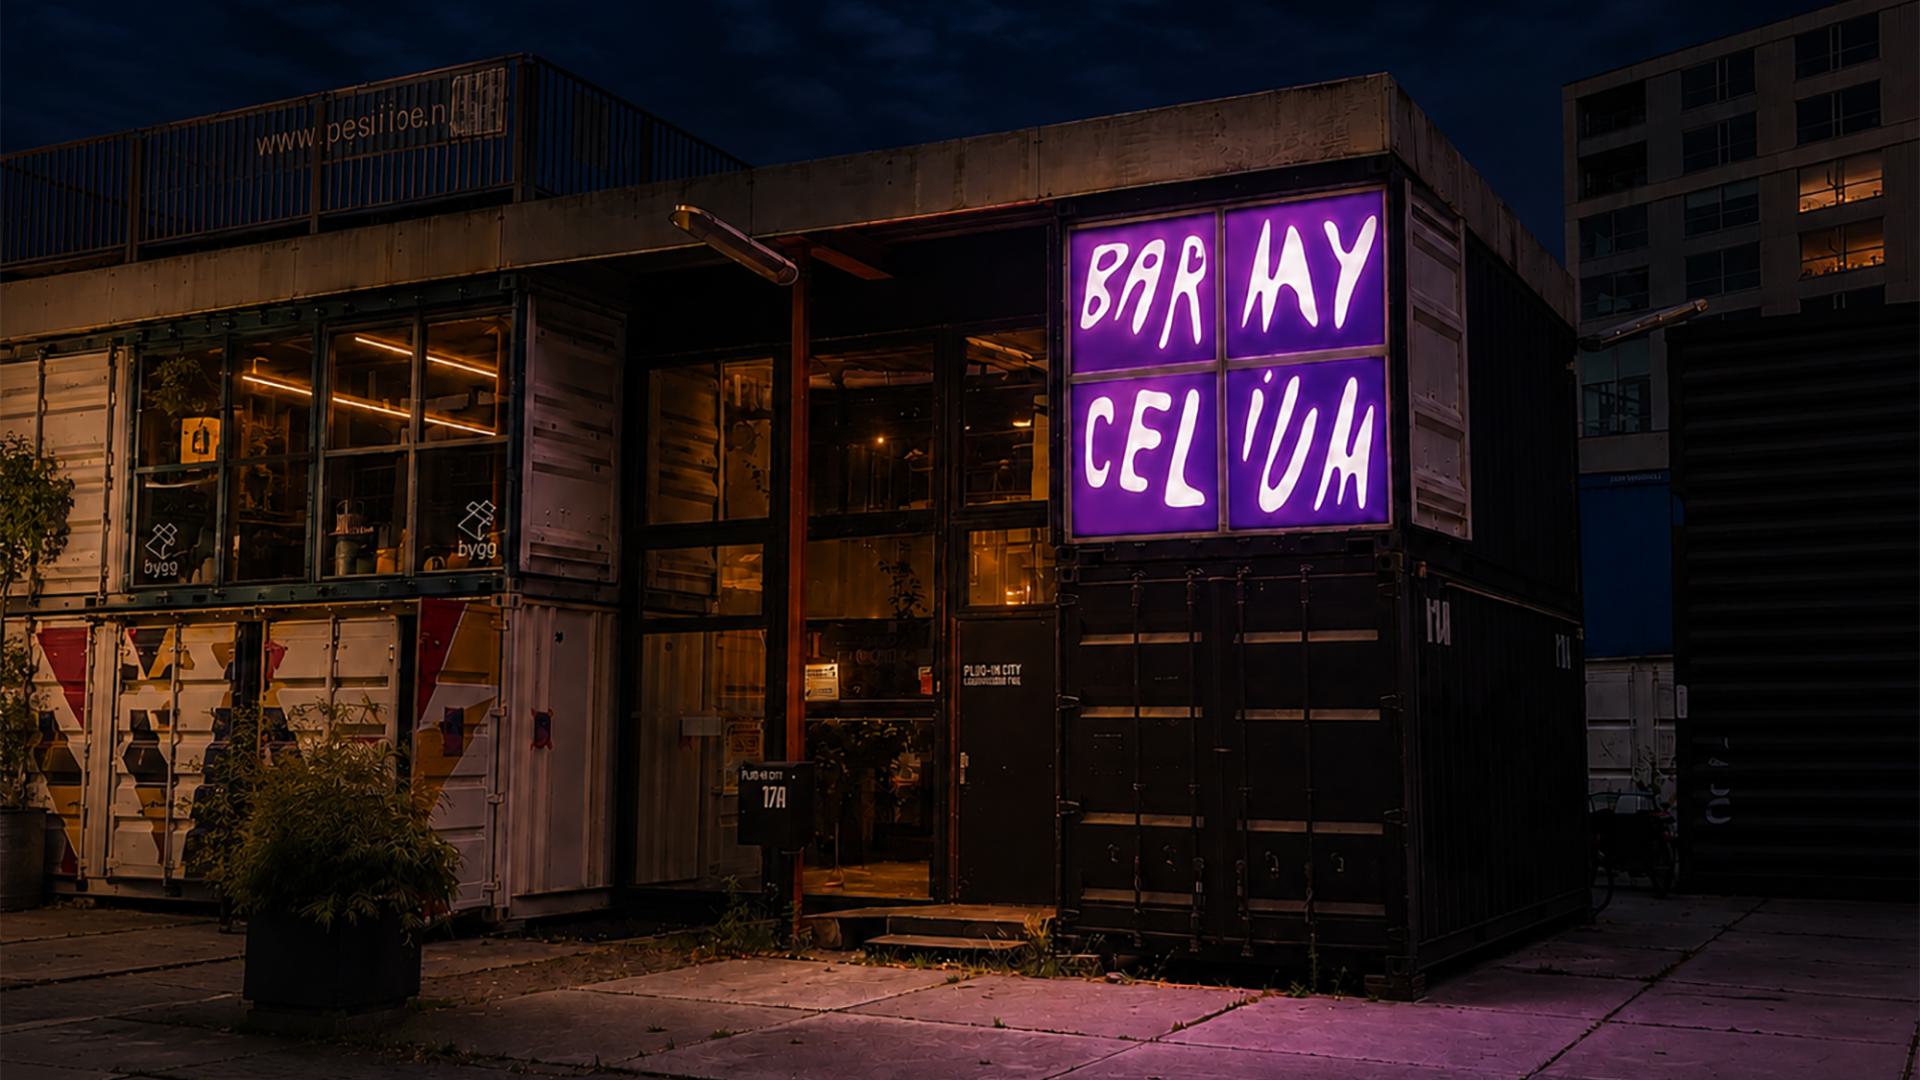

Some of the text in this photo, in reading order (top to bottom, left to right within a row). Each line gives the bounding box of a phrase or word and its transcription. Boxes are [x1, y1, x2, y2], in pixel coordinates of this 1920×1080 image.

[1079, 214, 1378, 350] BAR MY
[457, 540, 497, 561] bygg
[143, 558, 178, 579] bygg
[761, 785, 787, 809] 17A
